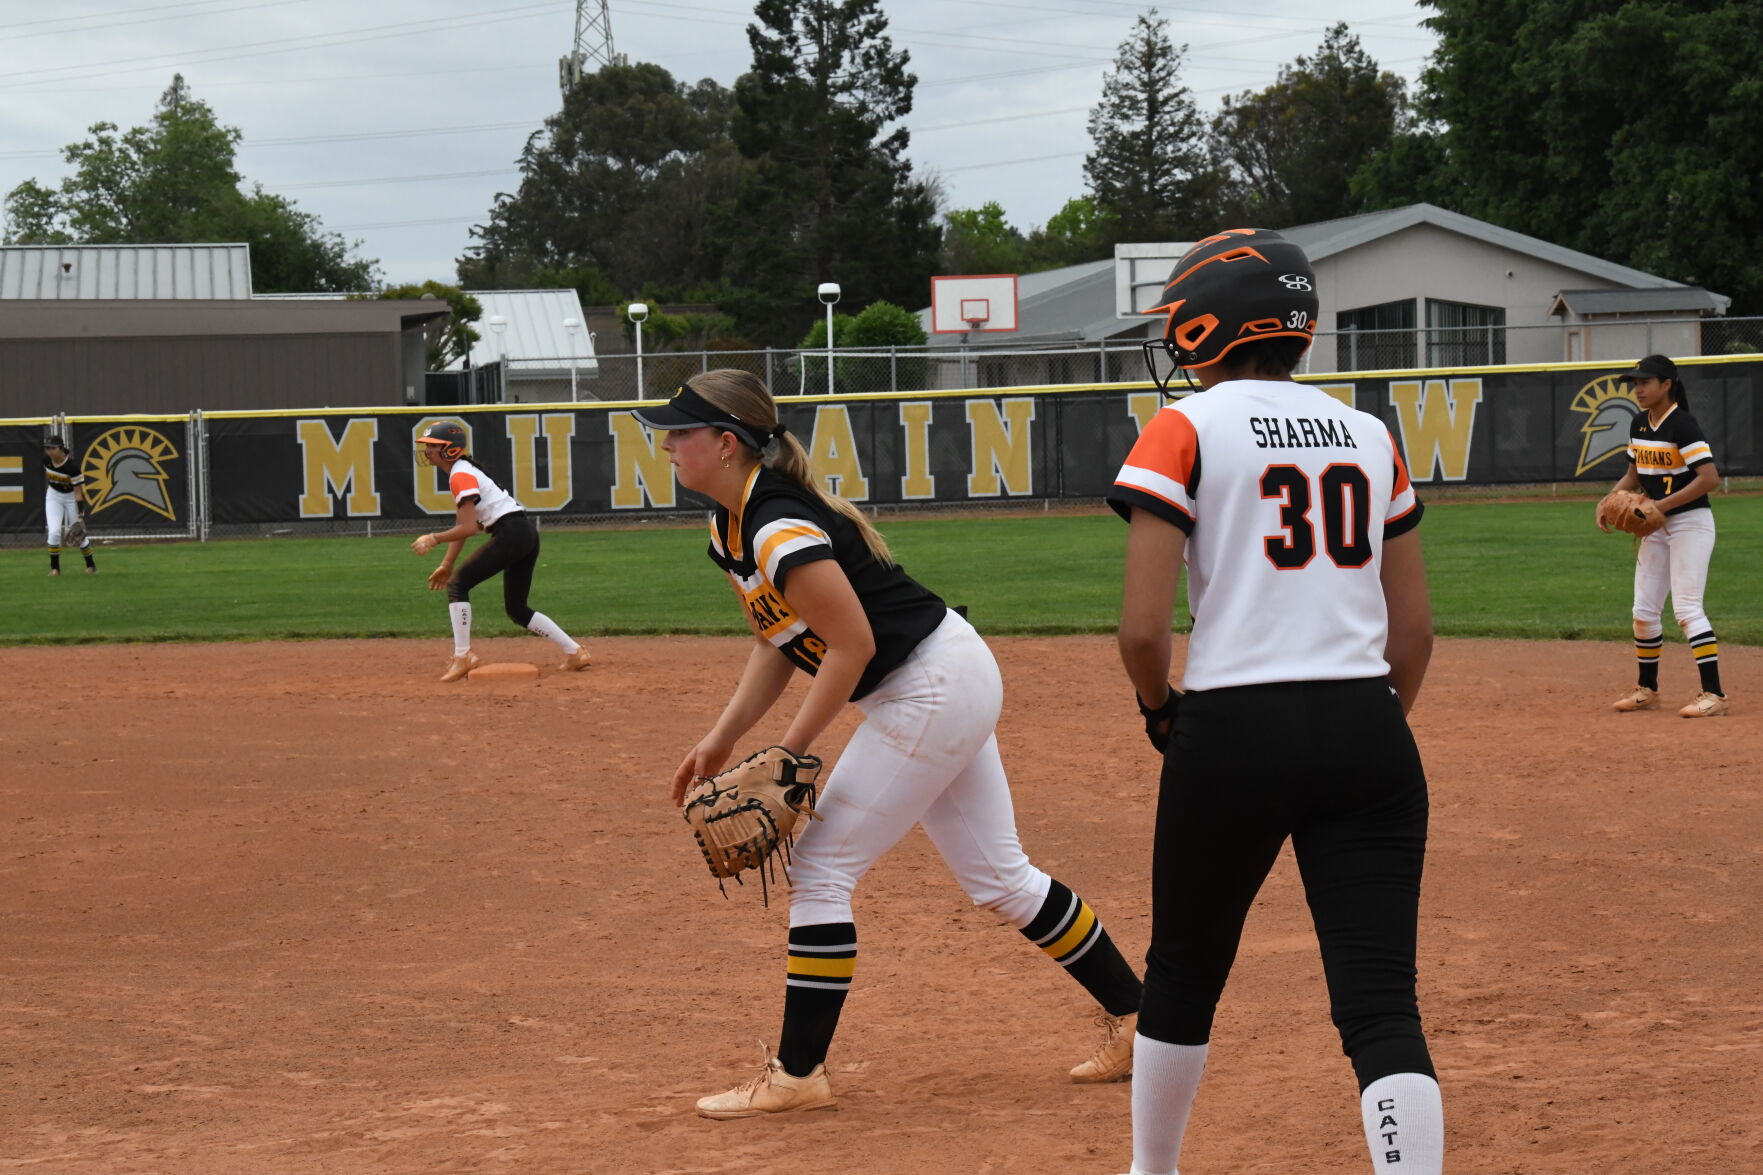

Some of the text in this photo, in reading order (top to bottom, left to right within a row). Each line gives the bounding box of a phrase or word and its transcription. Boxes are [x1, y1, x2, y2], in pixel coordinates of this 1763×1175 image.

[1287, 310, 1308, 329] 30
[1250, 417, 1358, 449] SHARMA
[297, 397, 1035, 518] MOUNAIN
[1662, 476, 1673, 495] 7
[1259, 462, 1374, 571] 30
[1377, 1098, 1401, 1163] CATS
